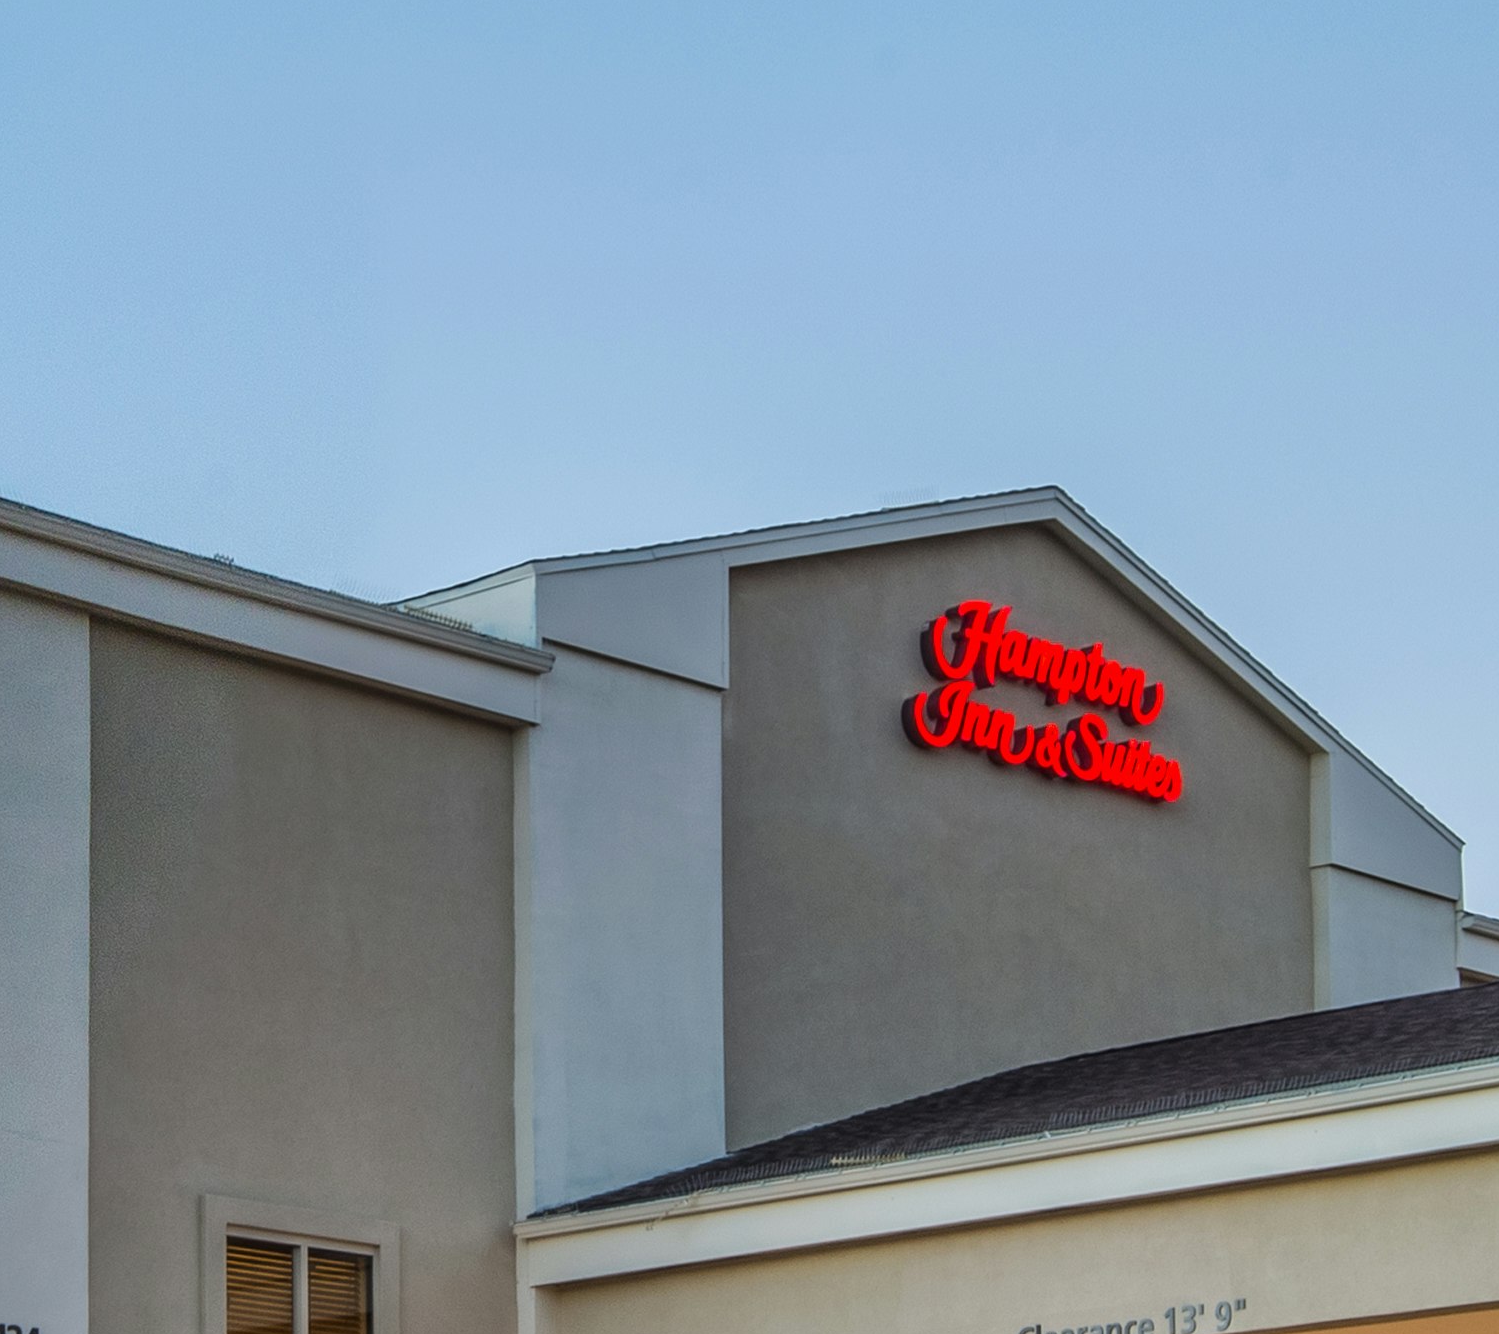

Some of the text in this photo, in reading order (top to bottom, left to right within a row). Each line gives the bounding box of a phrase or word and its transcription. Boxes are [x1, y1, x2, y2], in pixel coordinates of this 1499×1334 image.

[933, 600, 1163, 725] Hampton
[913, 680, 1183, 802] Inn & Suites
[1214, 1298, 1247, 1332] 9"
